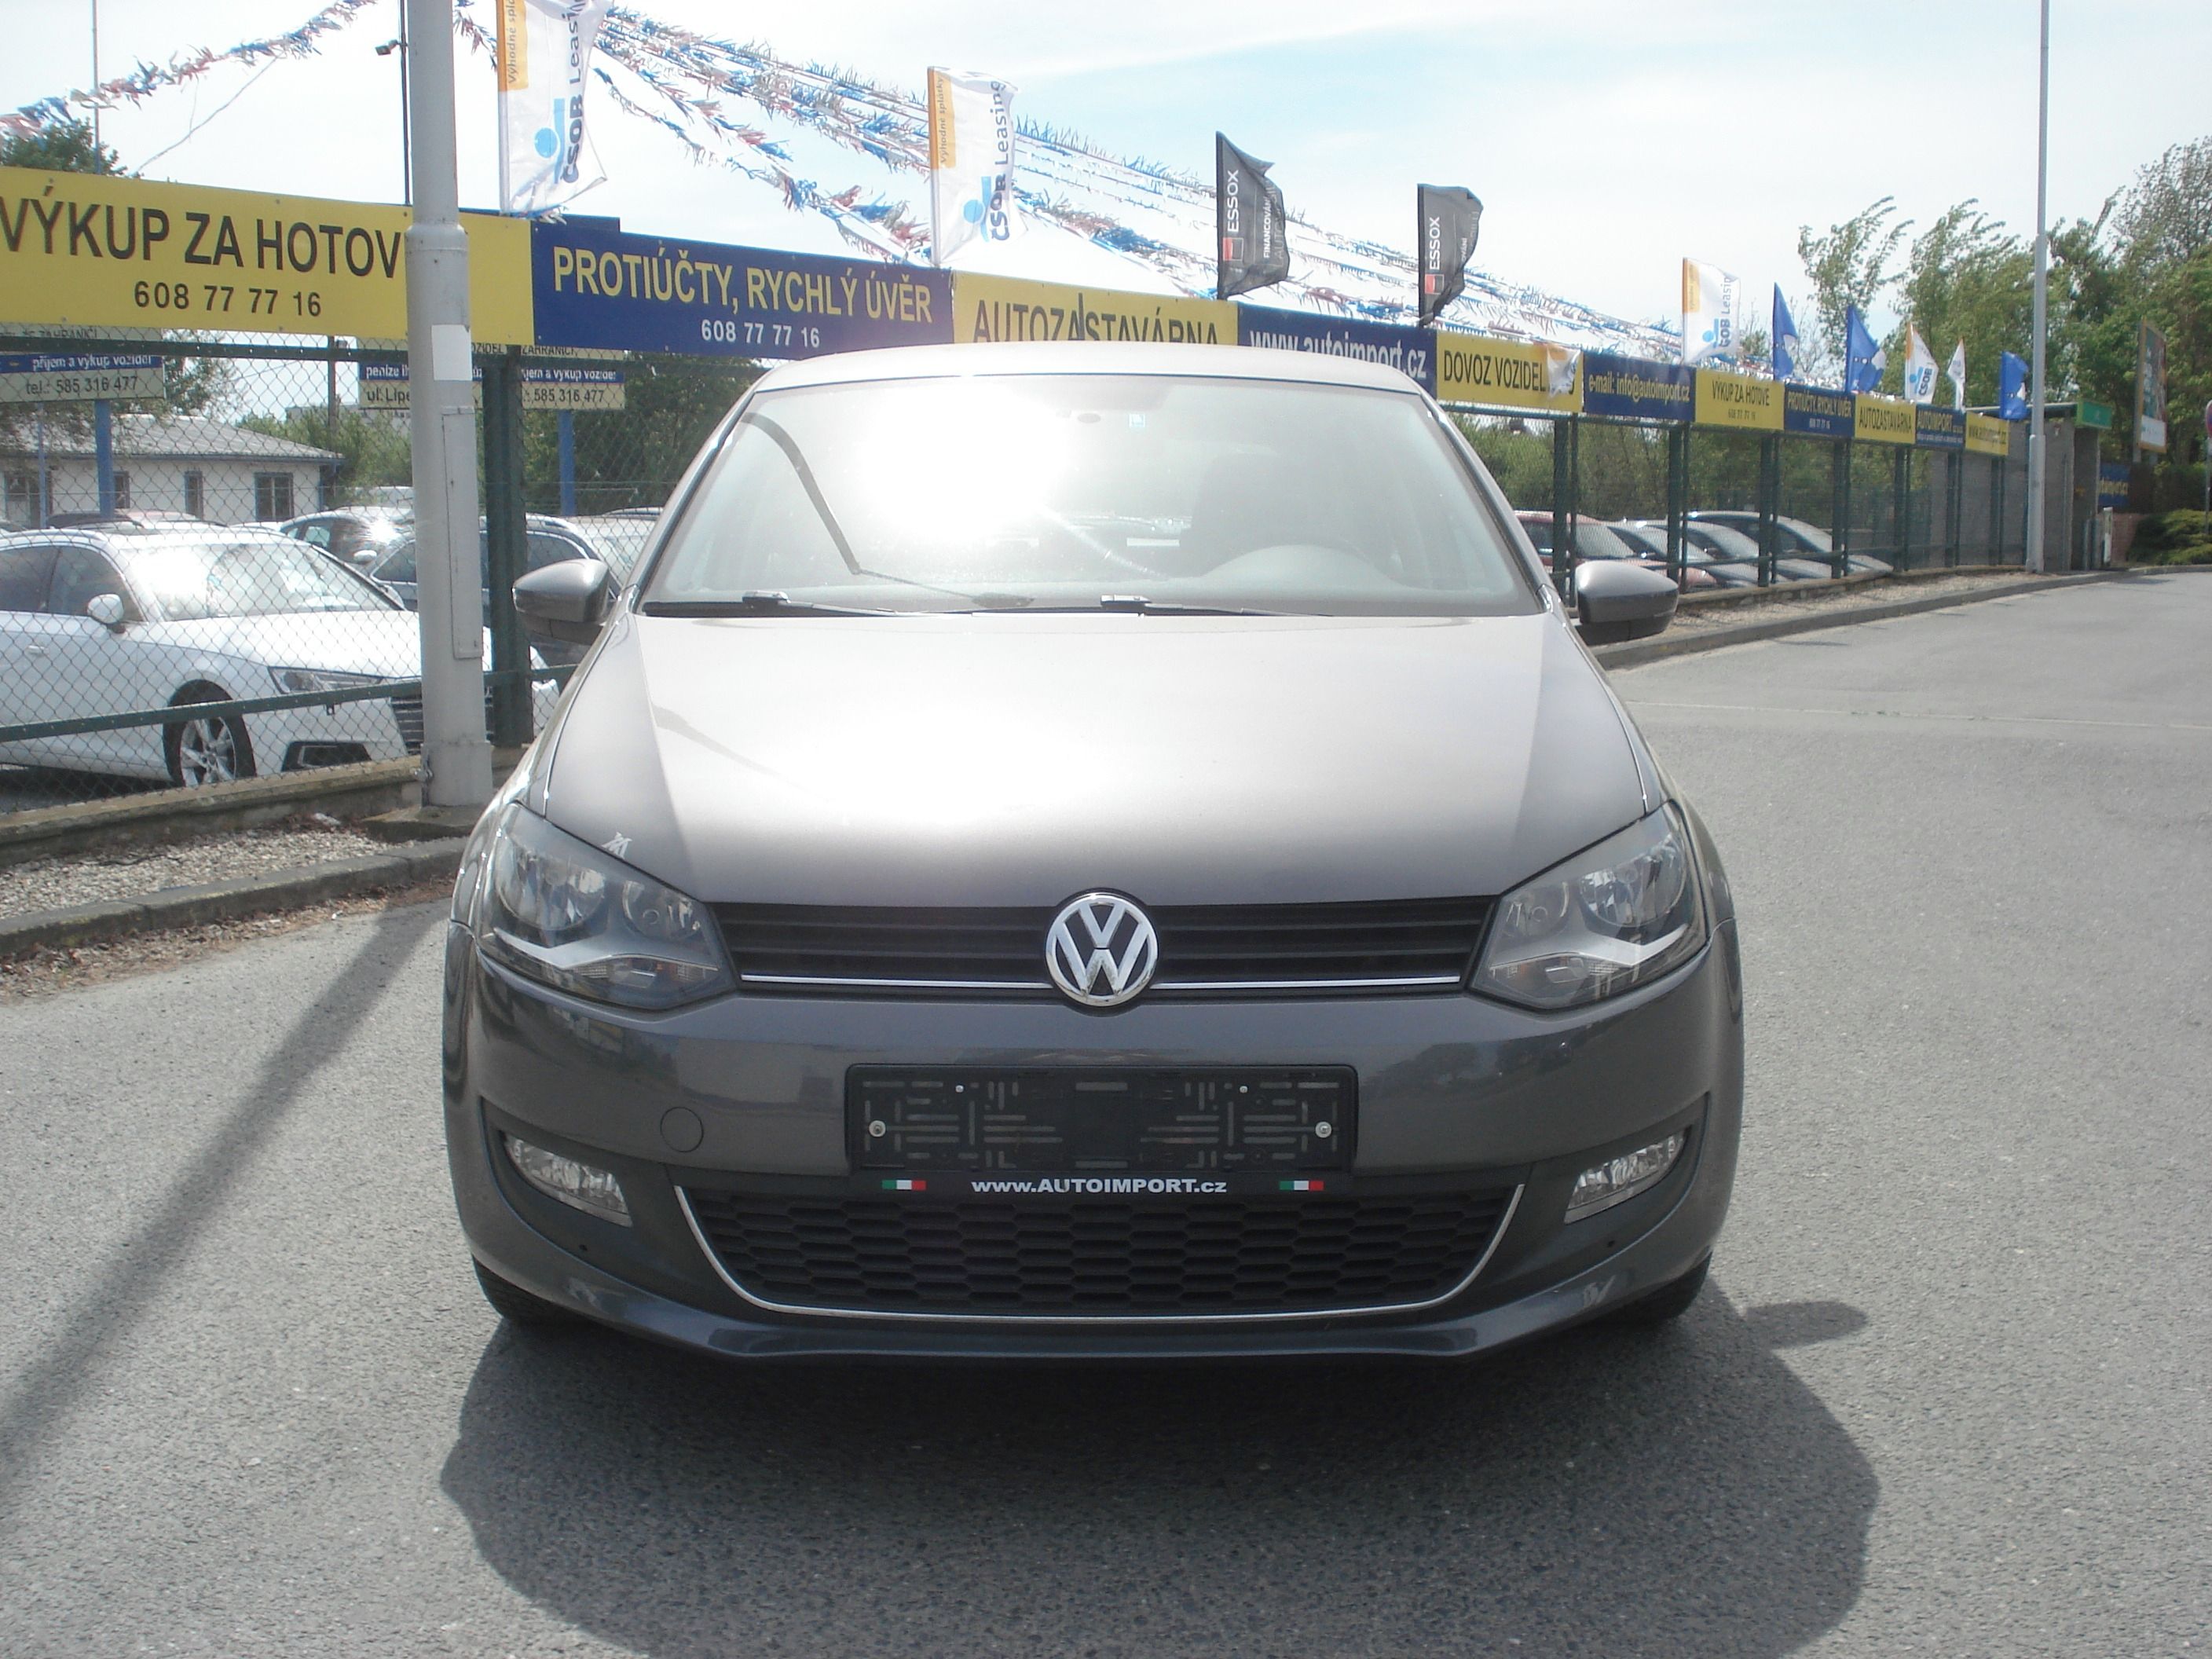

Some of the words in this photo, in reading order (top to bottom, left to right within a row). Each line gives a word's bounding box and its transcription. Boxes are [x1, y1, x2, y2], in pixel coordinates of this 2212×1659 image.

[990, 81, 1009, 165] Leasing
[1227, 170, 1239, 233] ESSOX
[0, 185, 170, 260] VÝKUP
[185, 211, 244, 267] ZA
[256, 218, 401, 278] HOTOV
[1263, 196, 1272, 258] FINANCOVÁN
[1429, 217, 1441, 270] ESSOX
[134, 280, 189, 309] 608
[203, 285, 235, 312] 77
[248, 287, 278, 314] 77
[292, 291, 321, 317] 16
[553, 246, 738, 315] PROTIÚČTY,
[746, 267, 858, 317] RYCHLÝ
[866, 270, 932, 324] ÚVĚR
[701, 319, 736, 343] 608
[744, 322, 764, 344] 77
[772, 324, 793, 346] 77
[801, 327, 820, 348] 16
[69, 358, 75, 368] a
[1250, 330, 1427, 379] wwwautoimport.cz
[1444, 350, 1491, 385] DOVOZ
[1496, 357, 1546, 392] VOZIDEL
[56, 379, 79, 394] 585
[85, 377, 108, 392] 316
[113, 375, 138, 390] 477
[534, 388, 555, 402] 585
[559, 388, 580, 402] 316
[584, 389, 604, 402] 477
[1588, 372, 1614, 394] e-mail:
[1617, 372, 1690, 405] info@autoimport.cz
[1734, 383, 1745, 403] ZA
[971, 1178, 1227, 1193] www.AUTOIMPORT.cz
